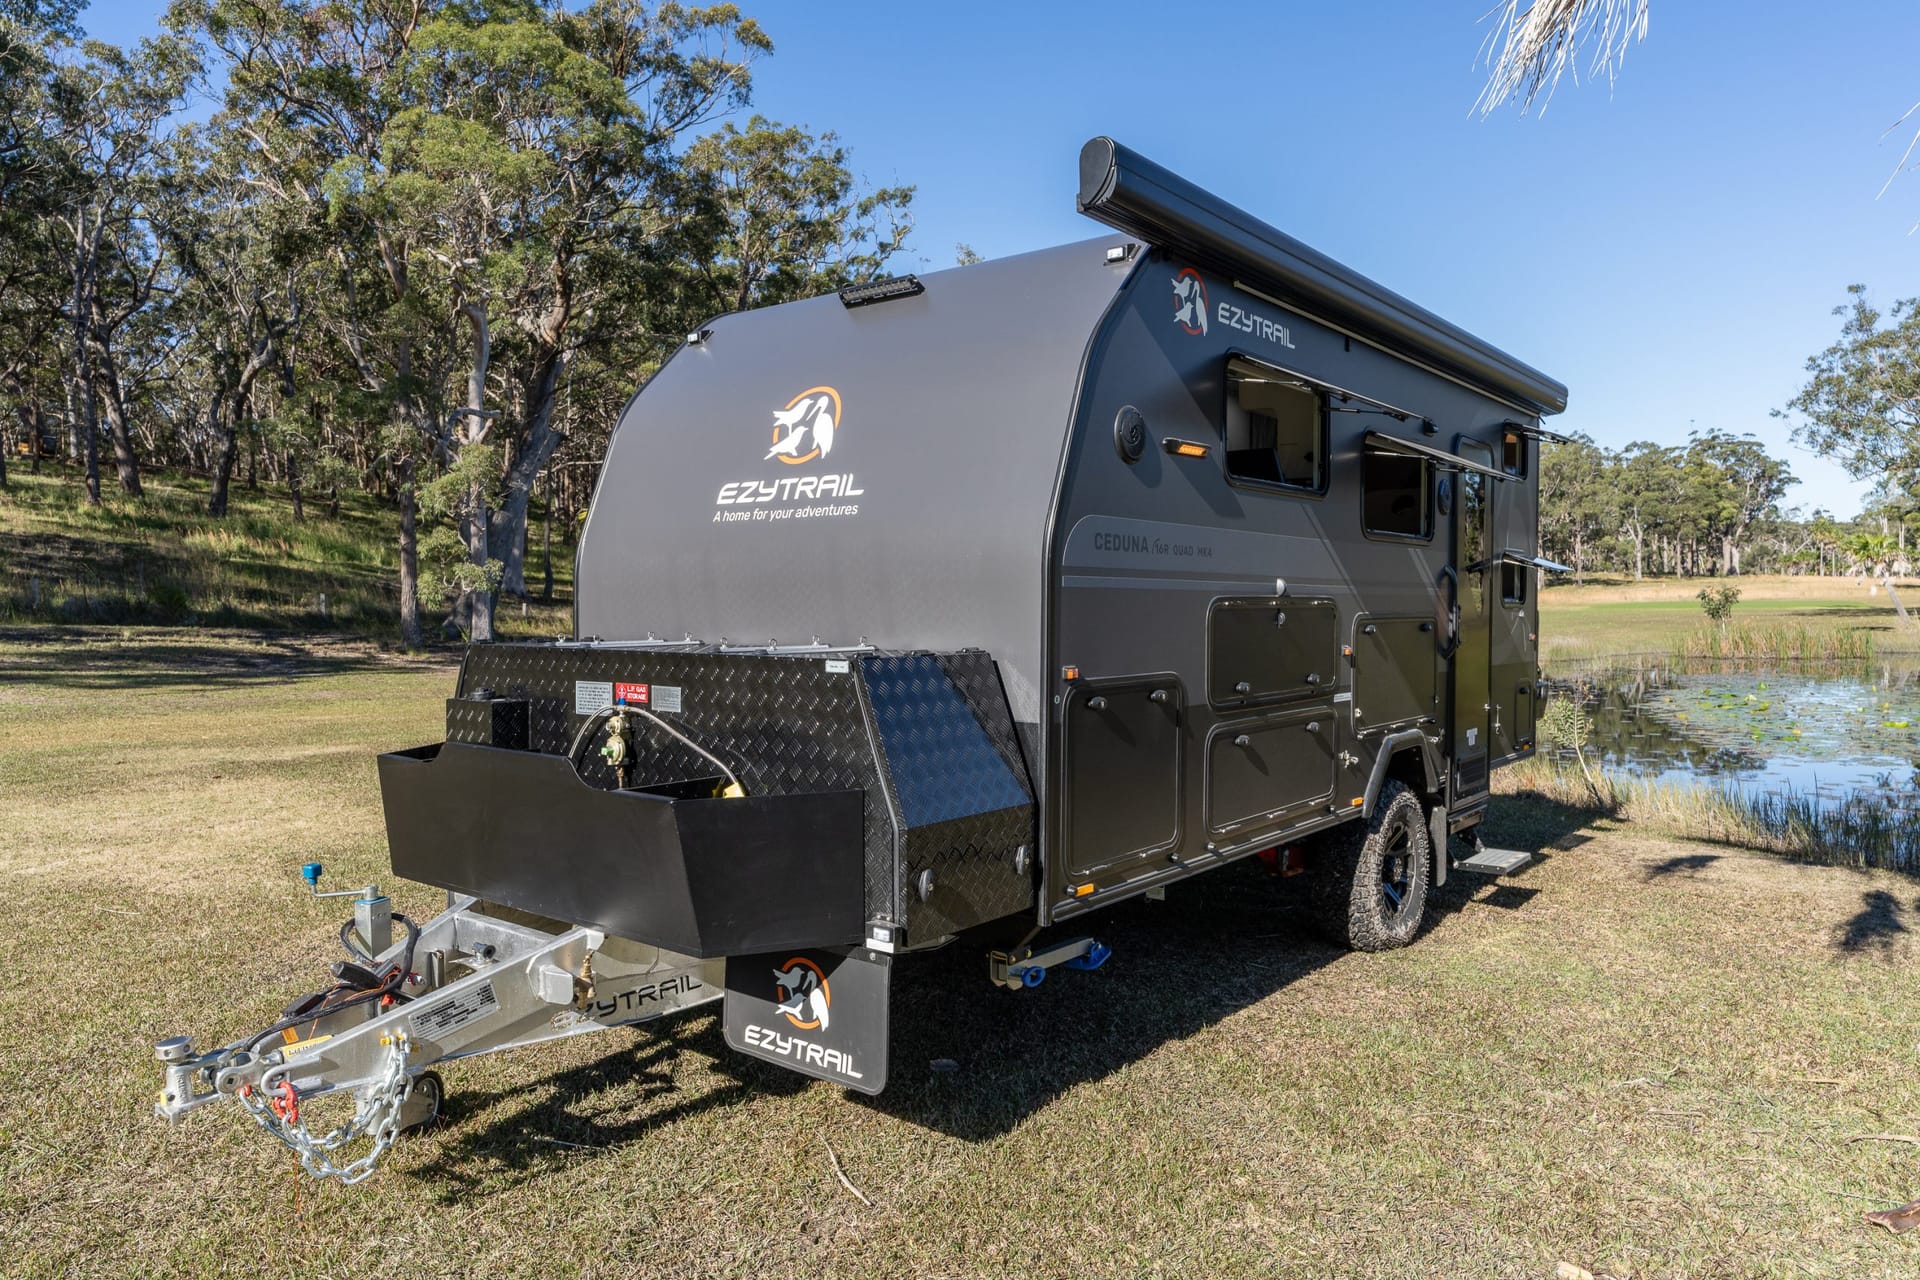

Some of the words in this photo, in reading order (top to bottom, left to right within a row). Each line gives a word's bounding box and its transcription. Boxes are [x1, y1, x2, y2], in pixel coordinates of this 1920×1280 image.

[1218, 302, 1295, 349] EZYTRAIL
[716, 473, 865, 505] EZYTRAIL
[713, 511, 721, 522] A
[722, 510, 751, 522] home
[752, 508, 768, 520] for
[769, 509, 794, 522] your
[795, 504, 859, 518] adventures
[1094, 532, 1149, 553] CEDUNA
[1173, 544, 1194, 557] QUAD
[577, 975, 703, 1017] YTRAIL
[744, 1024, 864, 1079] EZYTRAIL
